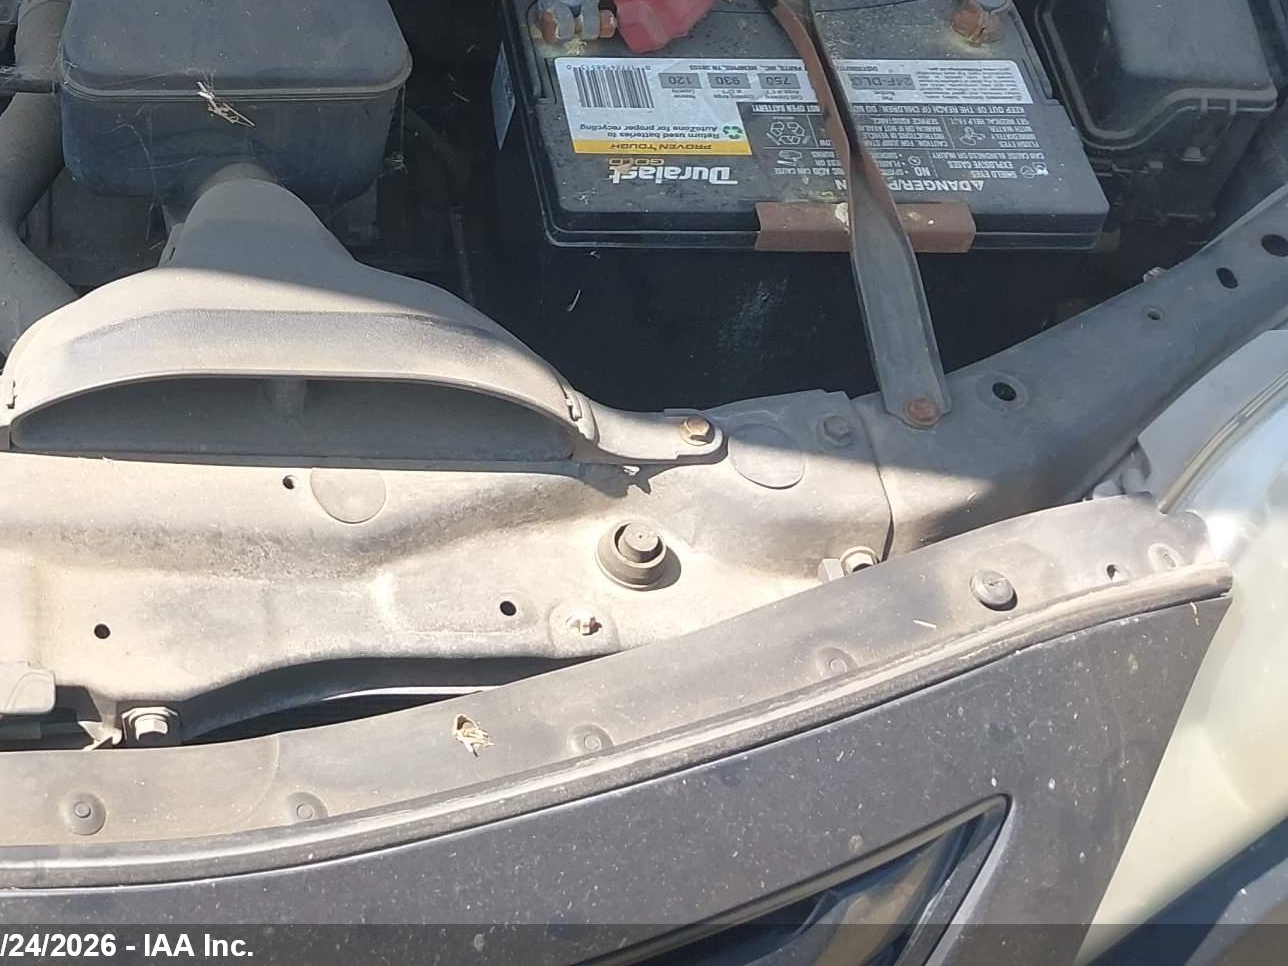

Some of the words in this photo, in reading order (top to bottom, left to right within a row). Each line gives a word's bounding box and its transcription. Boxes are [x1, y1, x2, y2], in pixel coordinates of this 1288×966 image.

[668, 76, 693, 85] 120
[715, 76, 741, 85] 930
[765, 76, 793, 85] 750
[610, 142, 658, 150] TOUGH
[659, 143, 712, 151] PROVEN
[608, 166, 738, 185] Duralast
